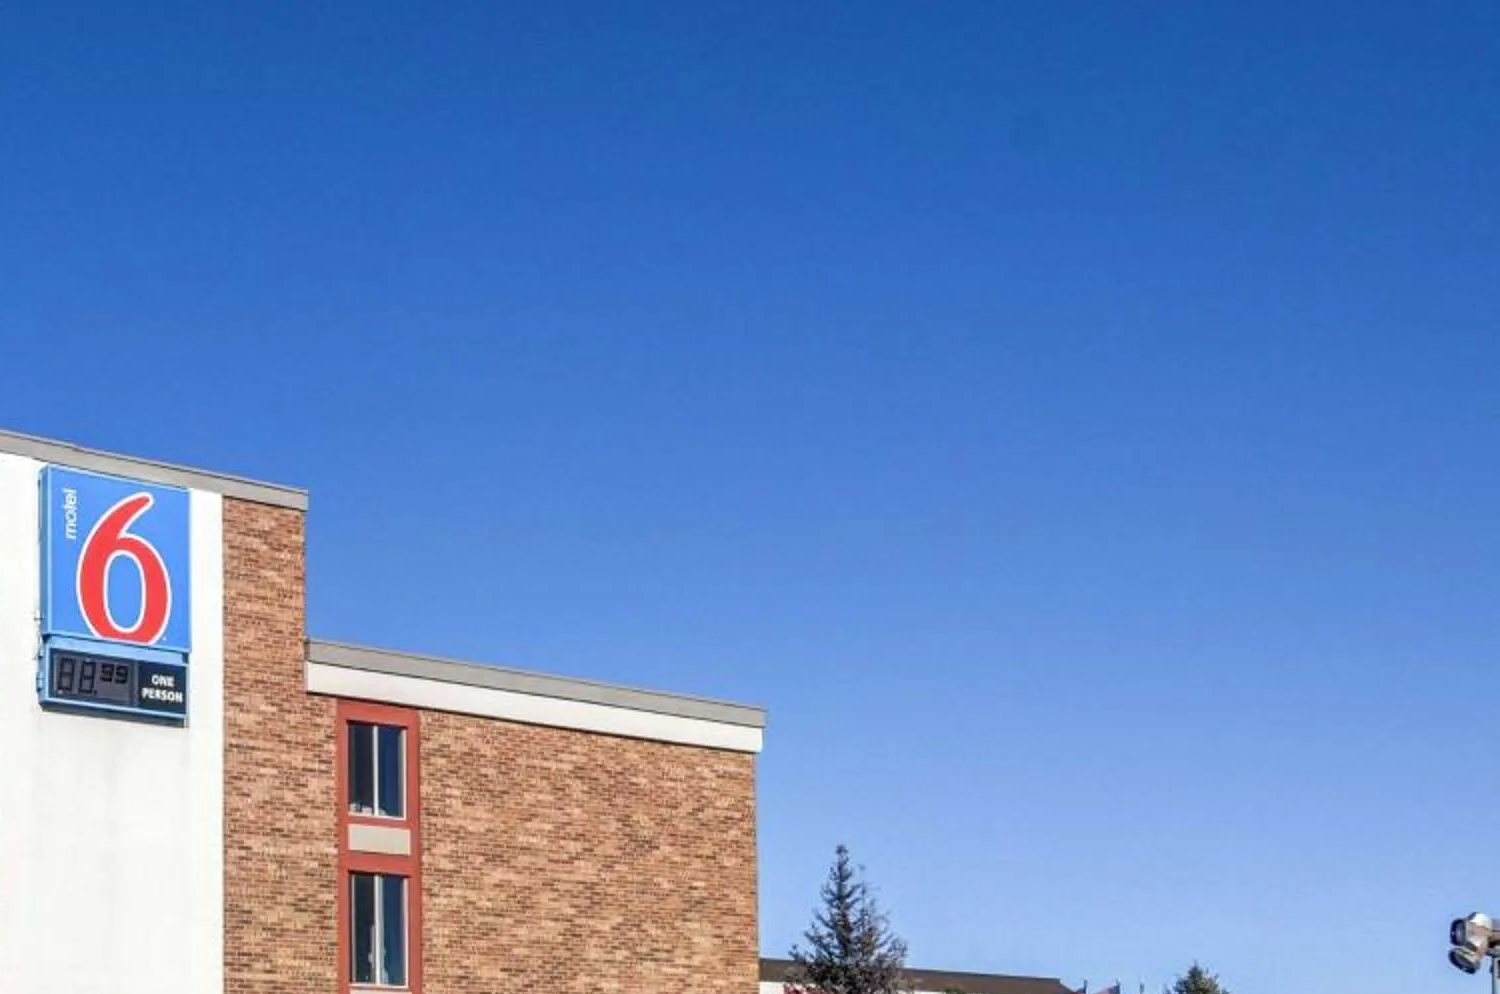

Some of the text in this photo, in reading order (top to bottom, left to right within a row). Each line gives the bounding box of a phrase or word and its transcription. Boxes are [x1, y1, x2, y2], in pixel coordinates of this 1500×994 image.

[62, 488, 77, 540] motel
[76, 492, 172, 645] 6
[141, 687, 183, 703] PERSON
[151, 674, 175, 687] ONE
